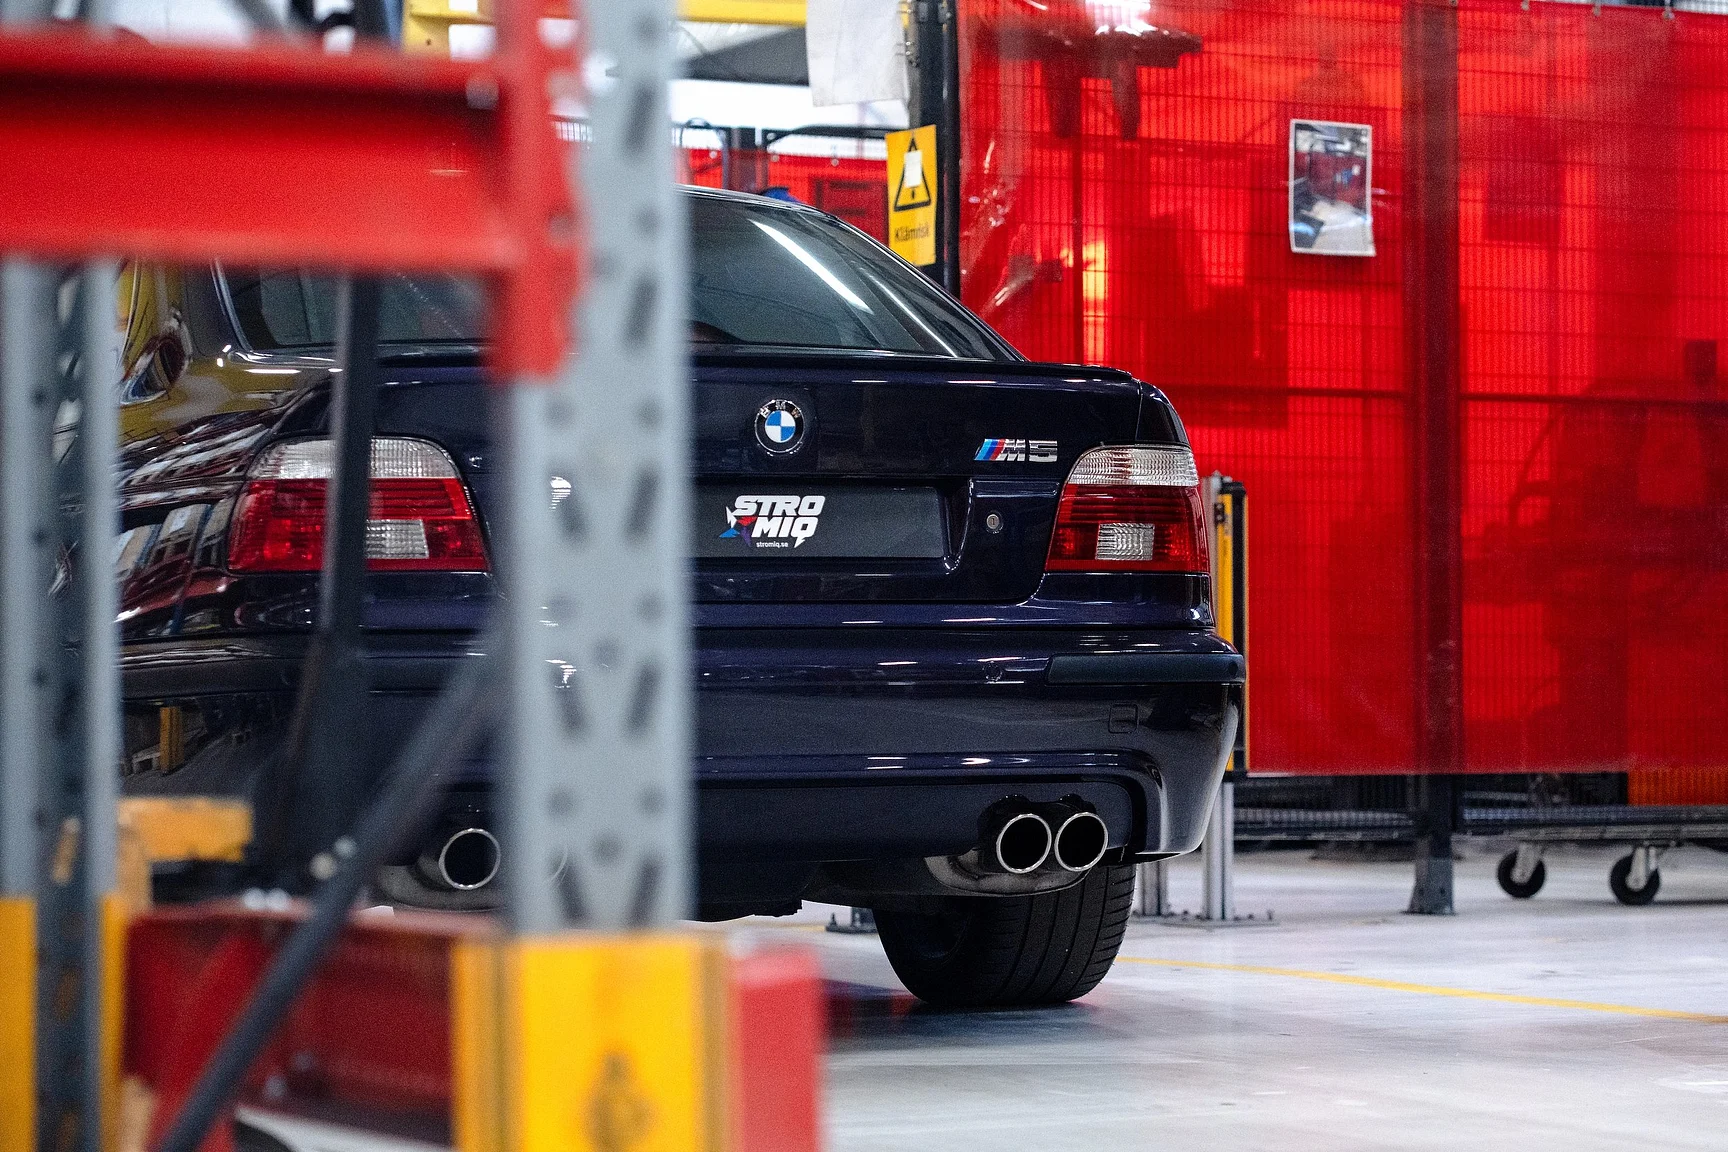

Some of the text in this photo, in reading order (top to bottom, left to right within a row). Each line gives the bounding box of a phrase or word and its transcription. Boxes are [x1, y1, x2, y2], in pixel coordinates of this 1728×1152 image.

[759, 401, 801, 418] BMW
[985, 438, 1058, 462] M5
[732, 495, 826, 516] STRO
[751, 516, 819, 548] MIQ
[756, 541, 789, 549] stromiq.se
